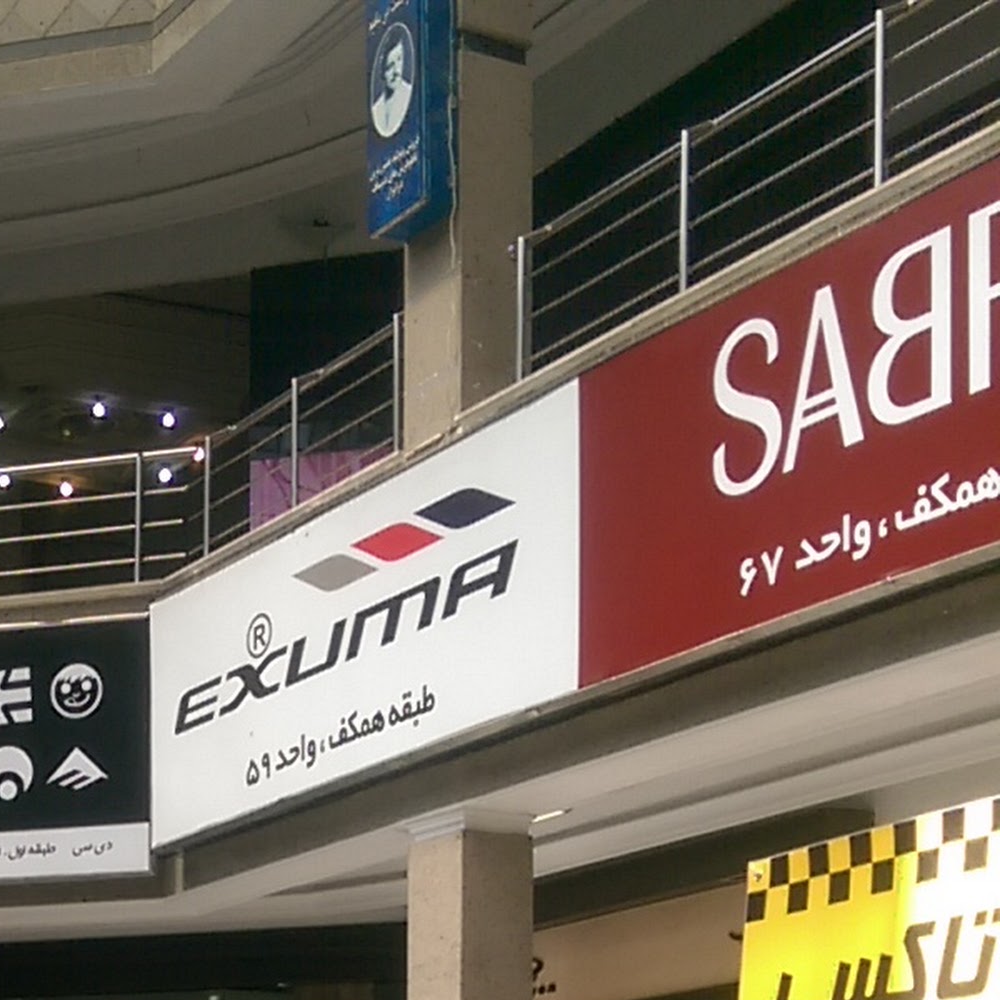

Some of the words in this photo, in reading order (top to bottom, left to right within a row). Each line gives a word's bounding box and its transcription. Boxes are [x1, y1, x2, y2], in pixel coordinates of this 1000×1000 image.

[795, 514, 871, 570] واحد
[739, 547, 785, 597] ۶۷
[174, 539, 519, 735] EXUMA
[388, 684, 435, 728] طبقه
[246, 753, 271, 787] ۵۹
[275, 733, 315, 768] واحد
[28, 842, 57, 857] طبقه
